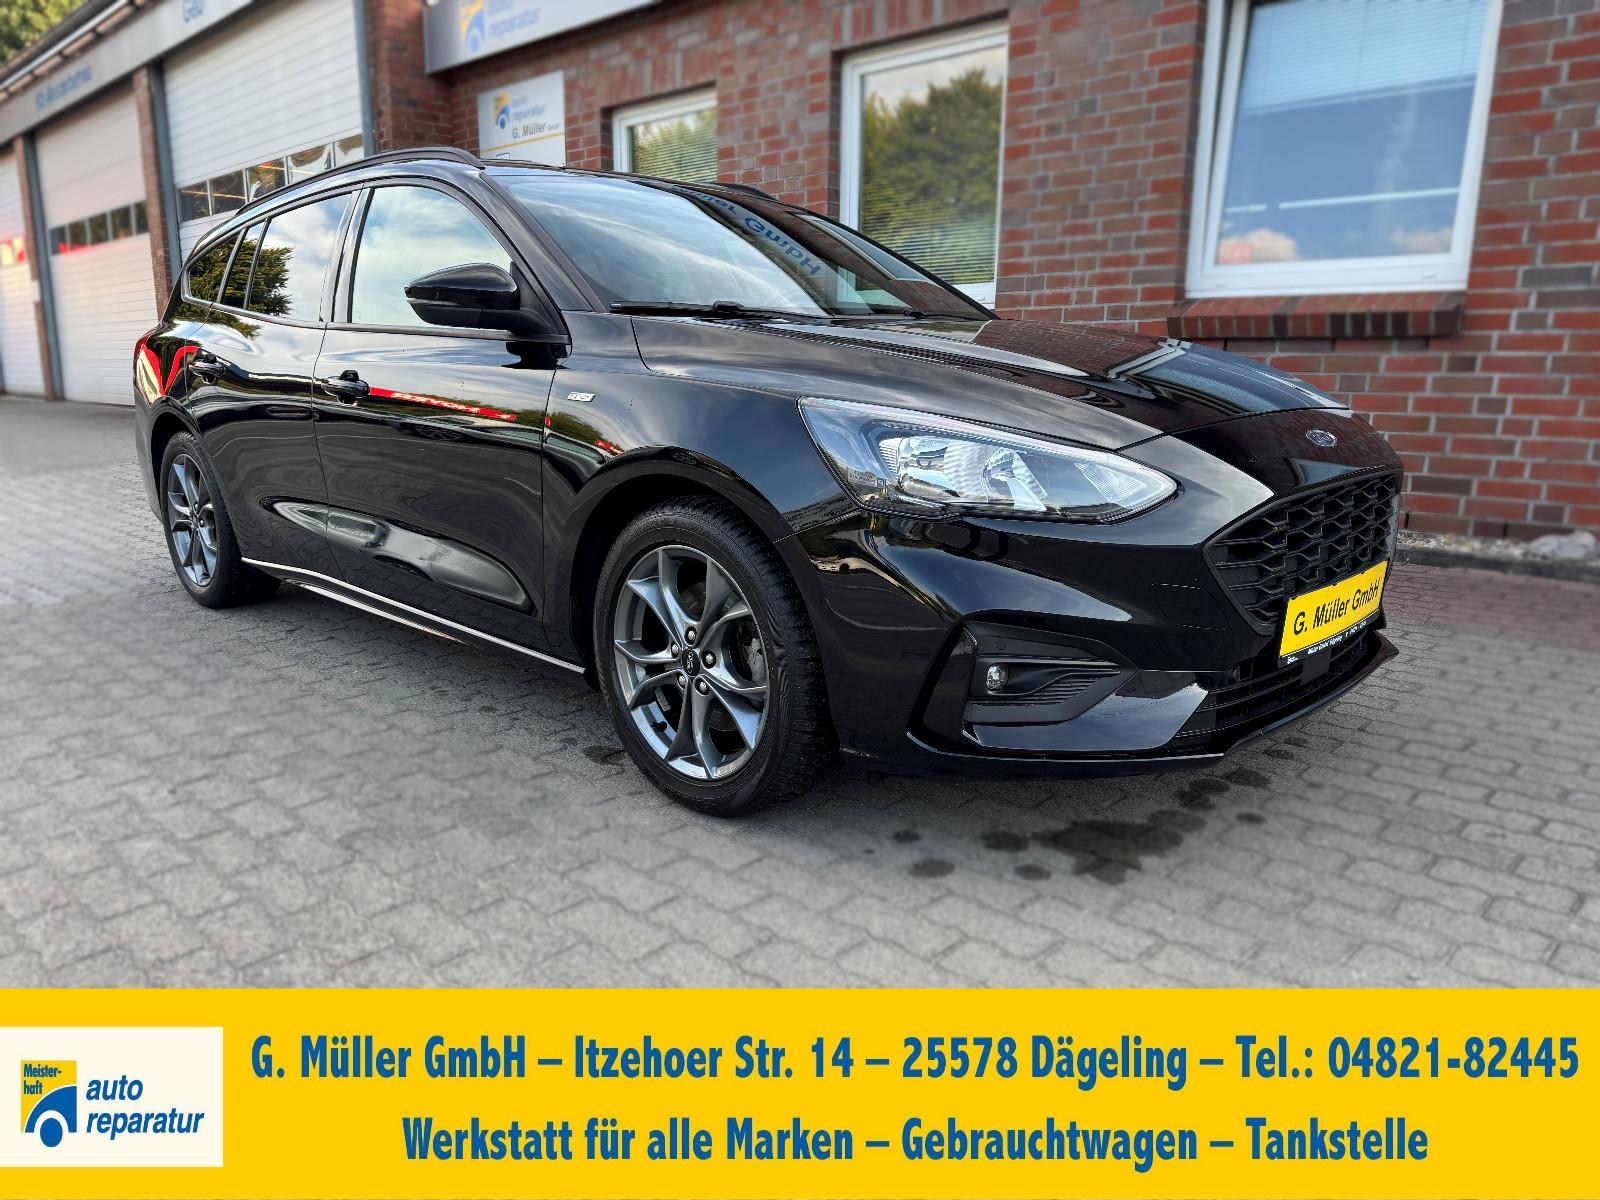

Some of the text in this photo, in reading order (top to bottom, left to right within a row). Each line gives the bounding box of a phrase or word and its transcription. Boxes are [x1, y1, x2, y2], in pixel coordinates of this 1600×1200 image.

[512, 127, 520, 139] G.
[522, 122, 546, 136] Müller
[1293, 611, 1308, 636] G.
[1313, 597, 1350, 629] Müller
[1352, 577, 1381, 611] GmbH
